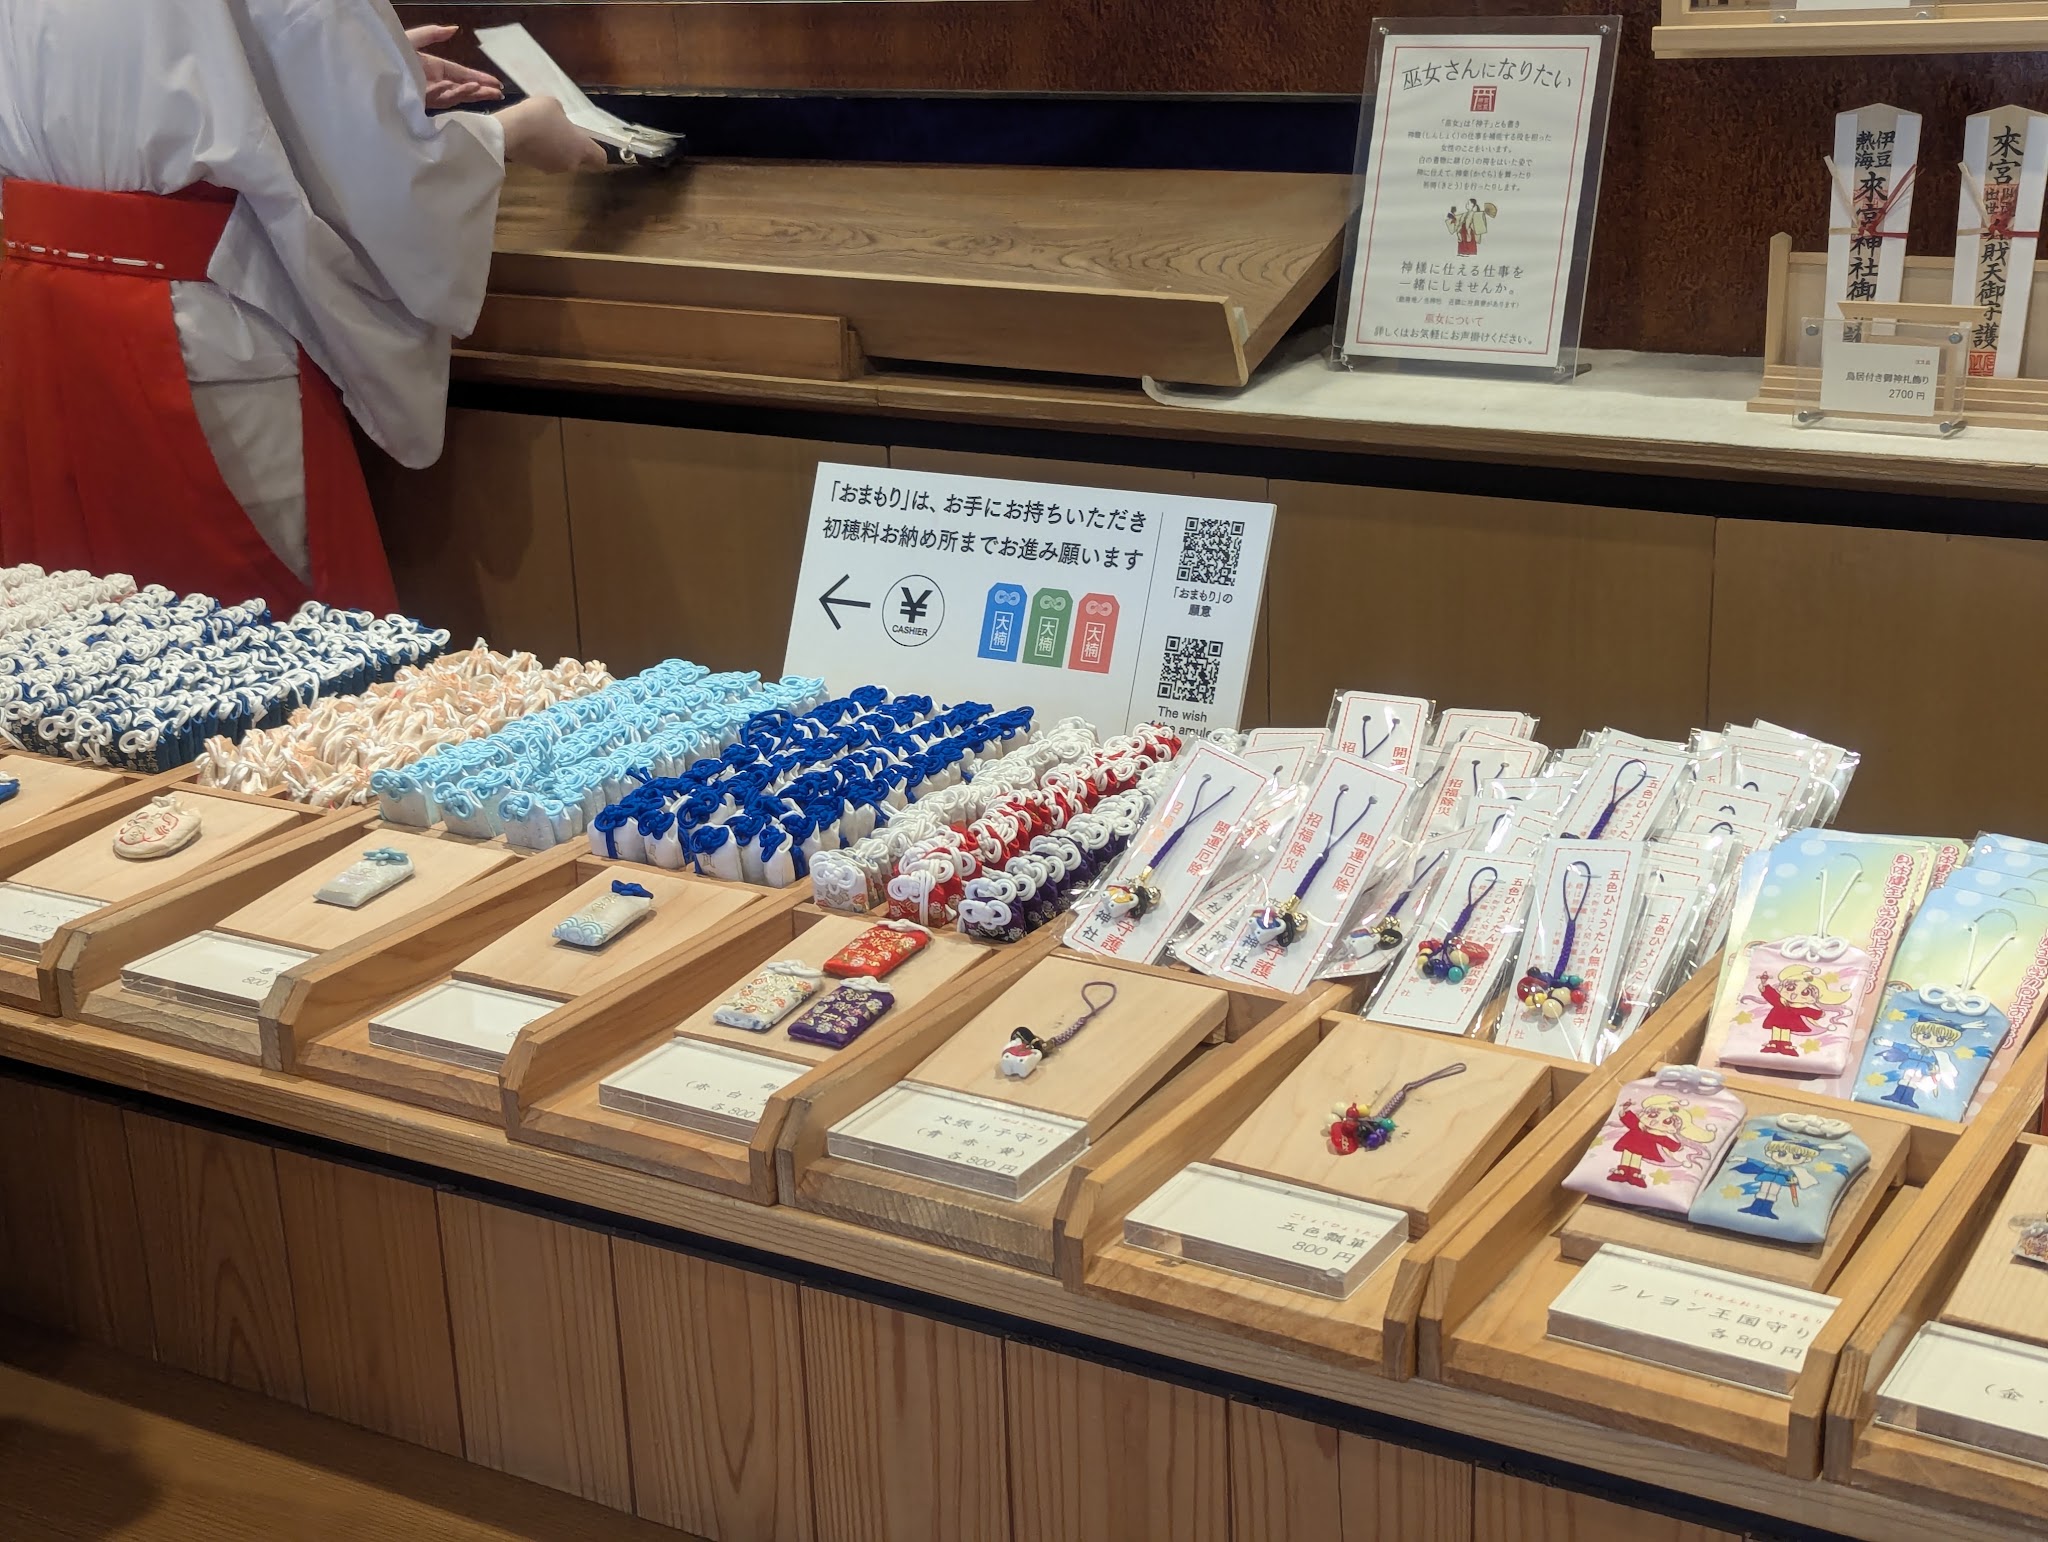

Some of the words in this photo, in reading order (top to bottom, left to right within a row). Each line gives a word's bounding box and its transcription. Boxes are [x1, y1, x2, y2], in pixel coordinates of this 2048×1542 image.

[1402, 57, 1572, 90] 巫女さんになりたい
[1854, 130, 1876, 170] 熱海
[1874, 130, 1896, 168] 伊豆
[1398, 278, 1515, 295] 一緒にしませんか。
[1400, 261, 1524, 279] 神様に仕える仕事を
[1374, 325, 1533, 345] 詳しくはお気軽にお声掛けください。
[1424, 313, 1484, 327] 巫女について
[822, 516, 1144, 571] 初穂料お納め所までお進み願います
[1172, 588, 1233, 604] 「おまもり」の
[1187, 604, 1212, 618] 願意
[891, 624, 929, 637] CASHIER
[993, 614, 1011, 648] 大楠
[1038, 619, 1057, 653] 大楠
[1083, 625, 1103, 659] 大楠
[1158, 705, 1179, 719] The
[1182, 709, 1207, 722] wish
[1280, 812, 1325, 874] 招福除災
[1331, 831, 1375, 893] 開運厄除
[1609, 1283, 1810, 1340] クレヨン王国守り
